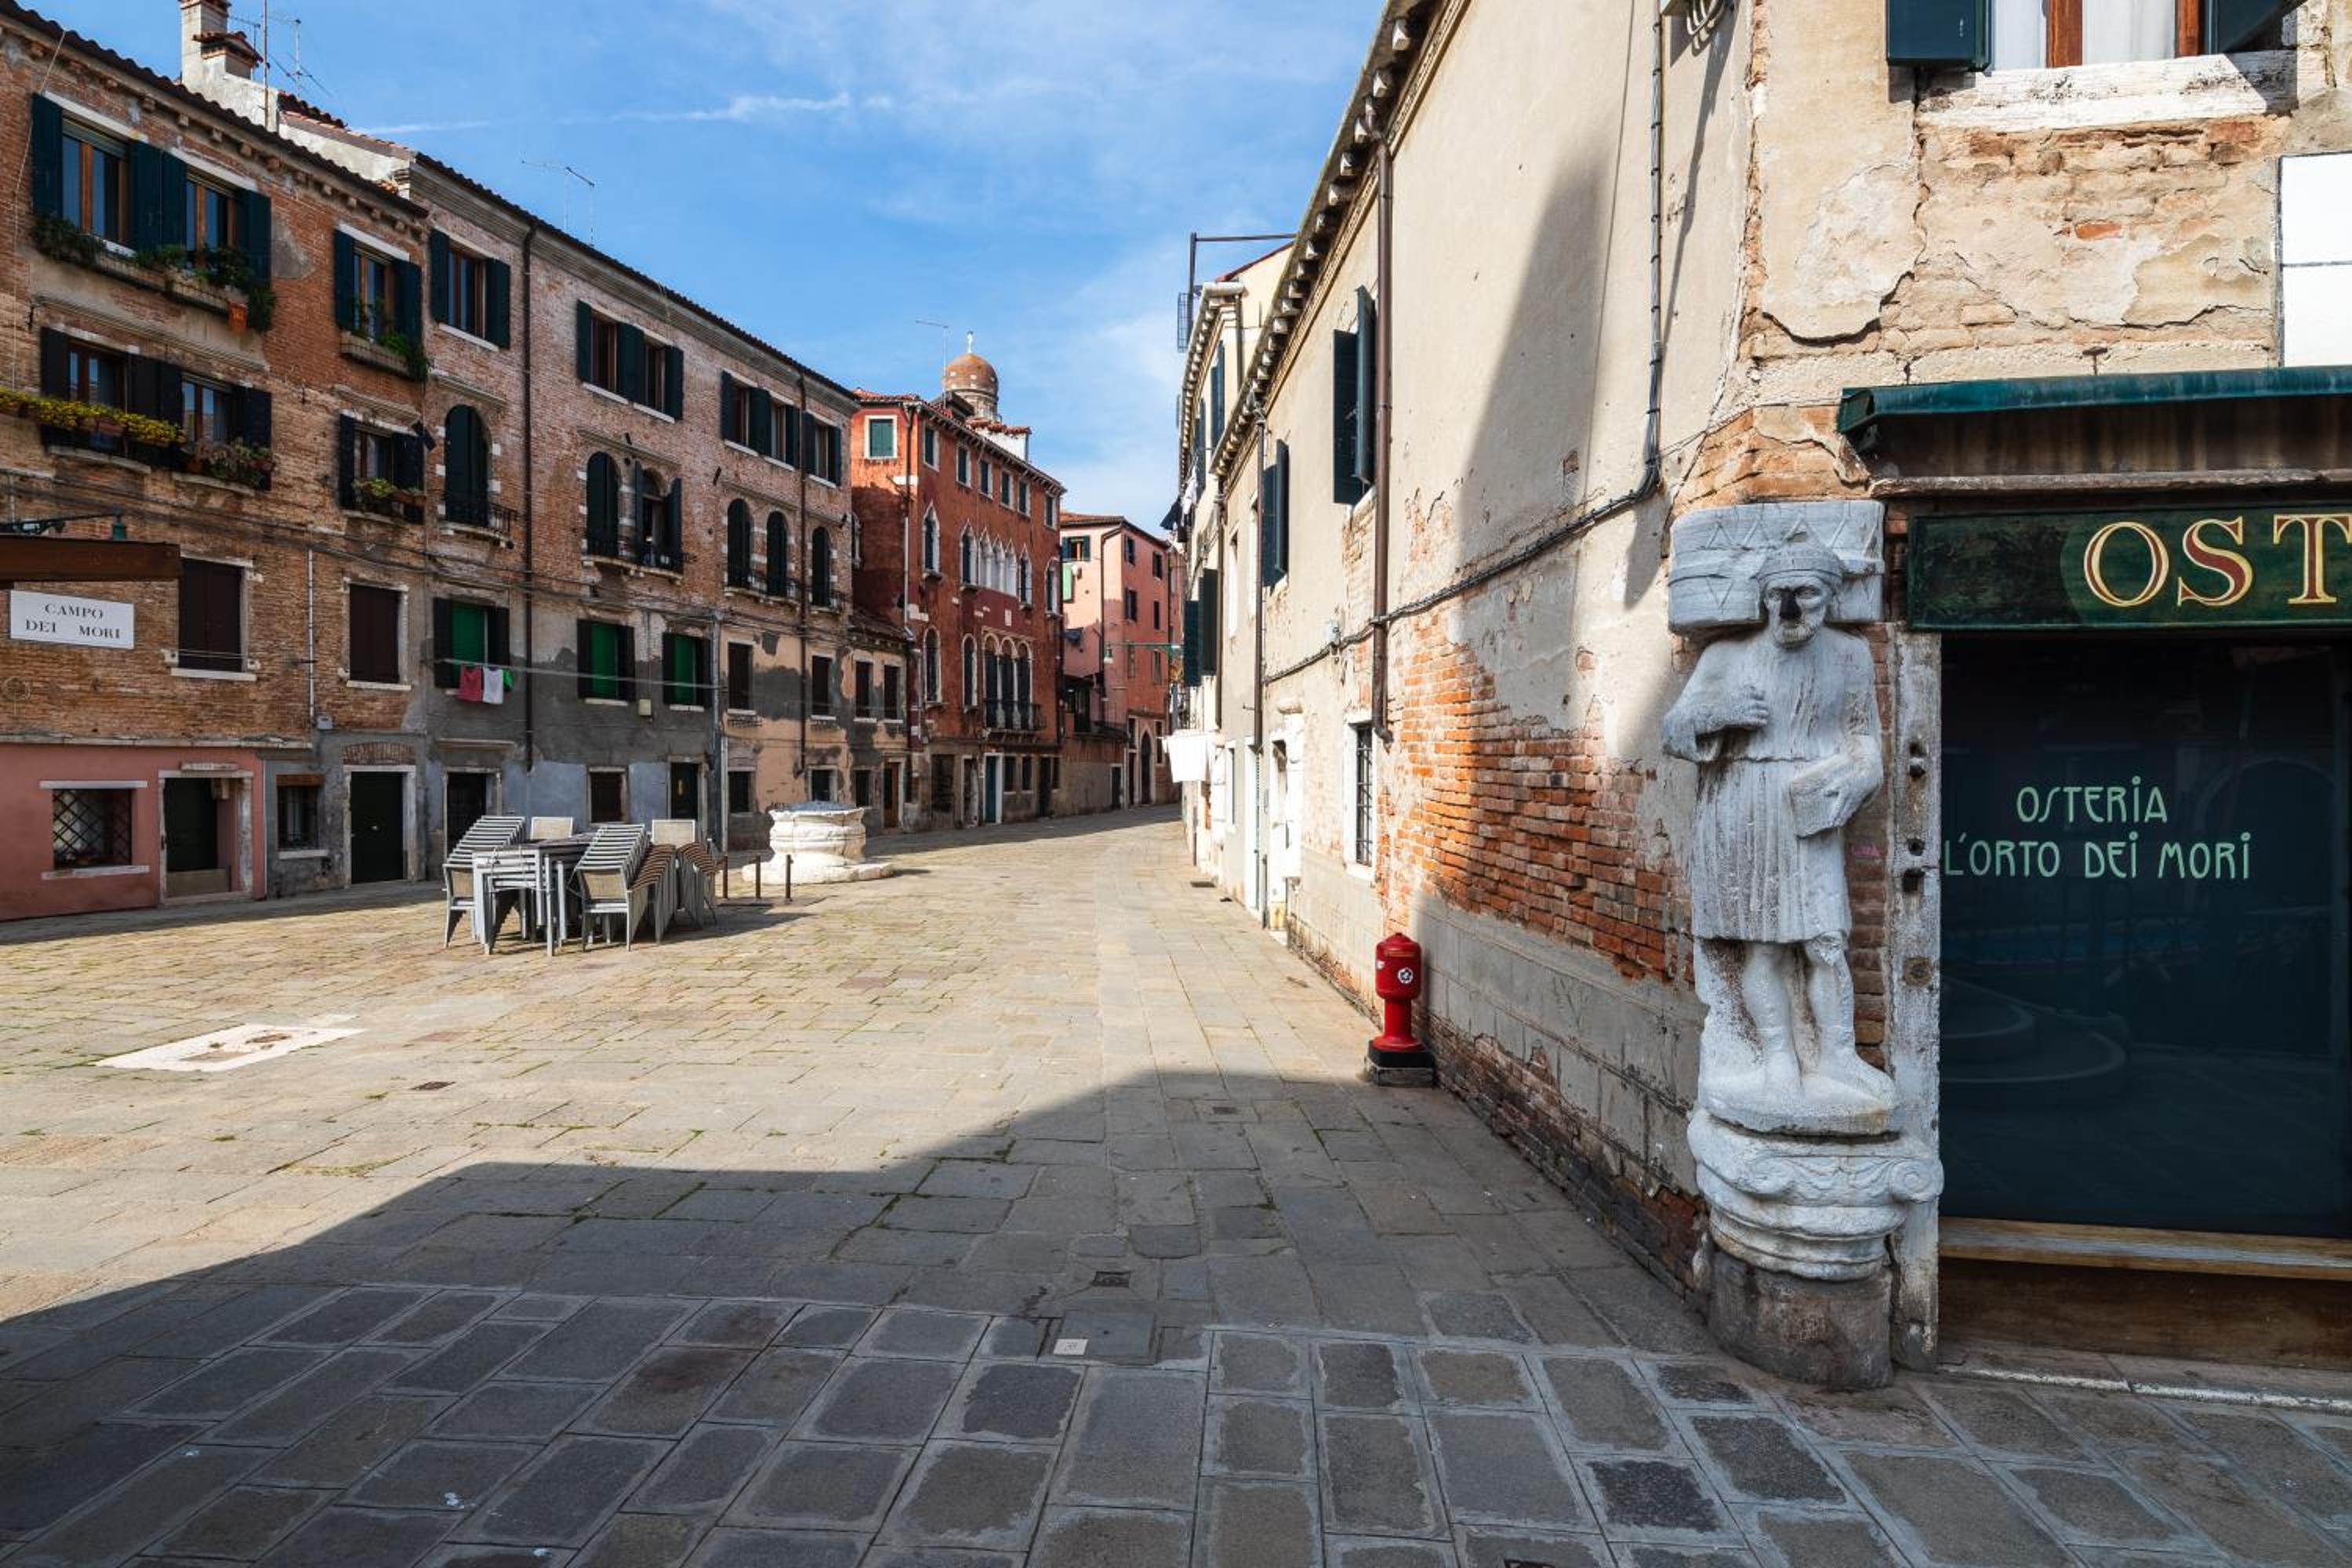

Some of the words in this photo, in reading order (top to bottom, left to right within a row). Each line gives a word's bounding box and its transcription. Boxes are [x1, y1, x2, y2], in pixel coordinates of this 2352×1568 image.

[2082, 513, 2352, 608] OST
[26, 619, 56, 633] DEI
[79, 625, 121, 639] MORI
[45, 603, 104, 619] CAMPO
[2016, 775, 2169, 823] OSTERIA
[1944, 832, 2060, 878] L'ORTO
